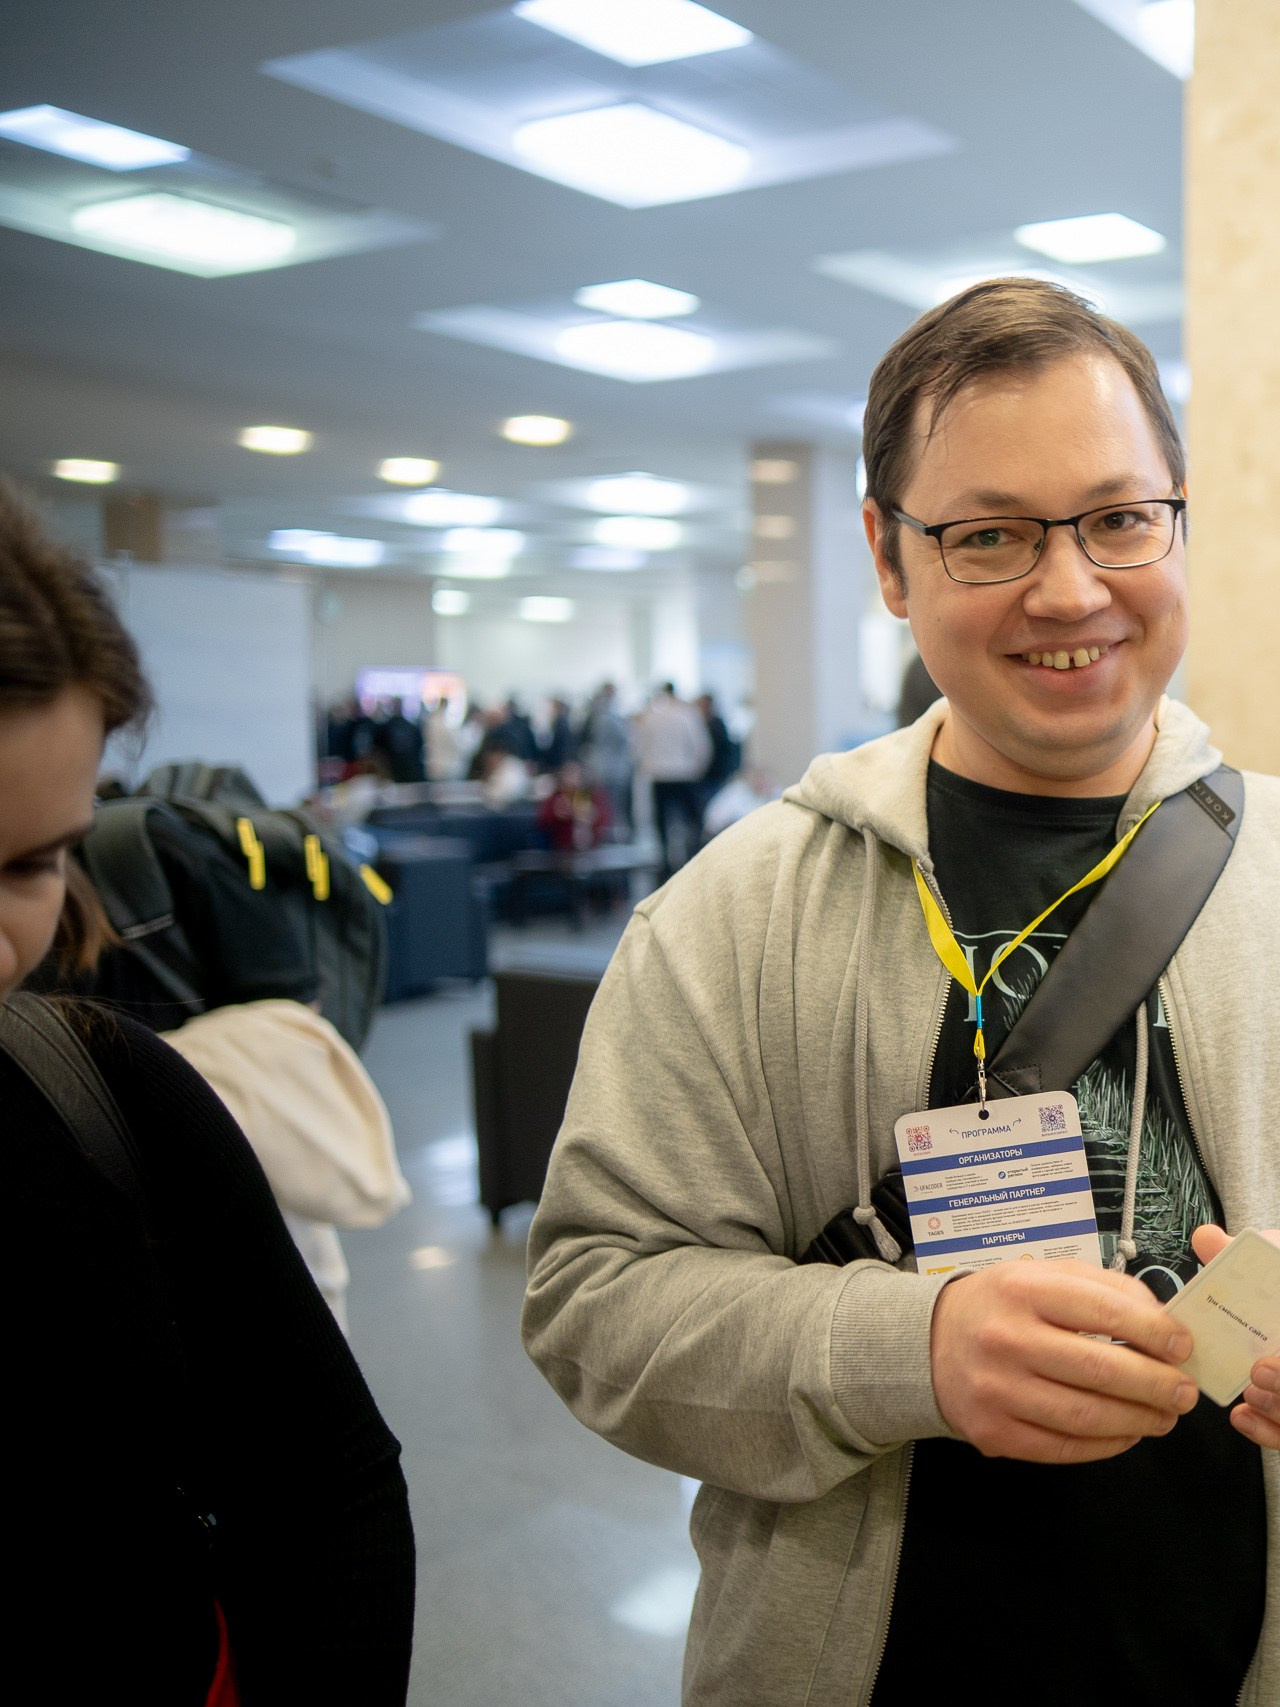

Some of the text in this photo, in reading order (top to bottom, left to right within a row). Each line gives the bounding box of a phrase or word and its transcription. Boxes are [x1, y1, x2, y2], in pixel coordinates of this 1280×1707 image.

[961, 1125, 1012, 1139] ПРОГРАММА
[958, 1148, 1023, 1165] ОРГАНИЗАТОРЫ
[920, 1182, 943, 1192] UFACODER
[948, 1187, 1046, 1208] ГЕНЕРАЛЬНЫЙ ПАРТНЕР
[982, 1232, 1025, 1245] ПАРТНЕРЫ
[1206, 1295, 1268, 1342] Три смешных сайта
